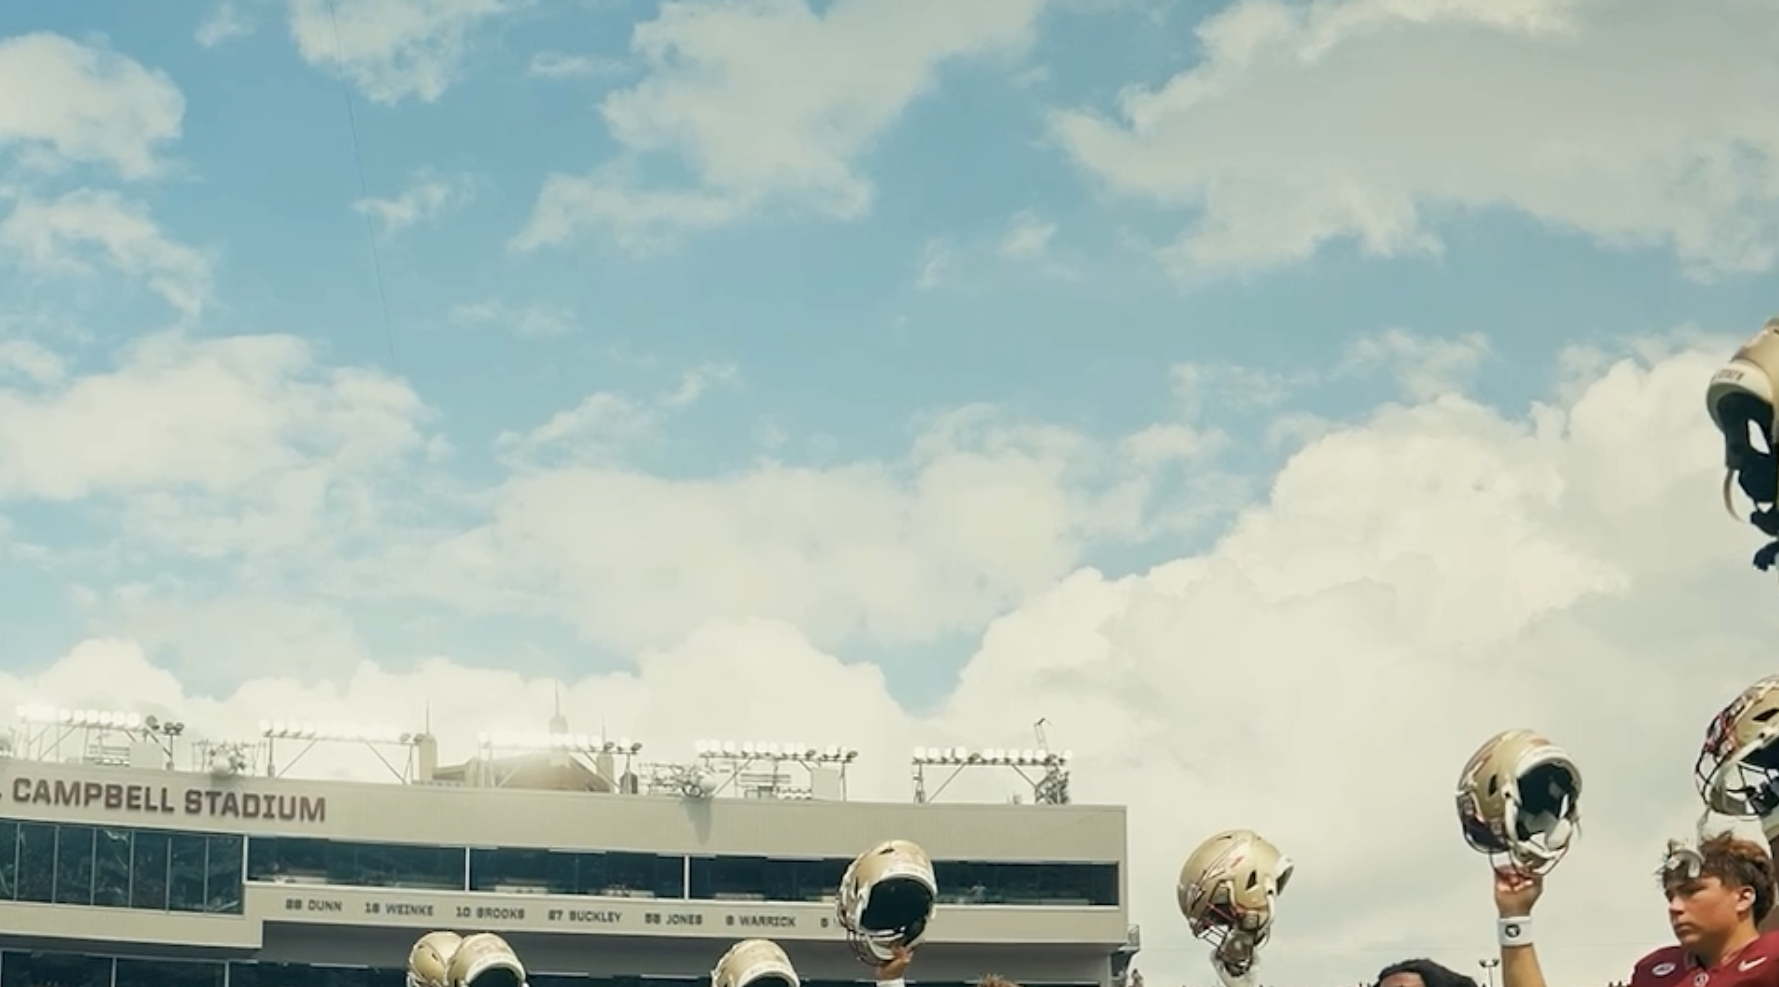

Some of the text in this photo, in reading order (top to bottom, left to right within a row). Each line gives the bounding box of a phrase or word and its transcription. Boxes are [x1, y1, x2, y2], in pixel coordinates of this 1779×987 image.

[13, 777, 175, 813] CAMPBELL
[184, 789, 327, 822] STADIUM
[307, 899, 343, 912] DUNN
[385, 904, 434, 917] WEINKE
[475, 907, 526, 919] BROOKS
[569, 910, 622, 924] BUCKLEY
[666, 913, 703, 925] JONES
[739, 915, 796, 928] WARRICK
